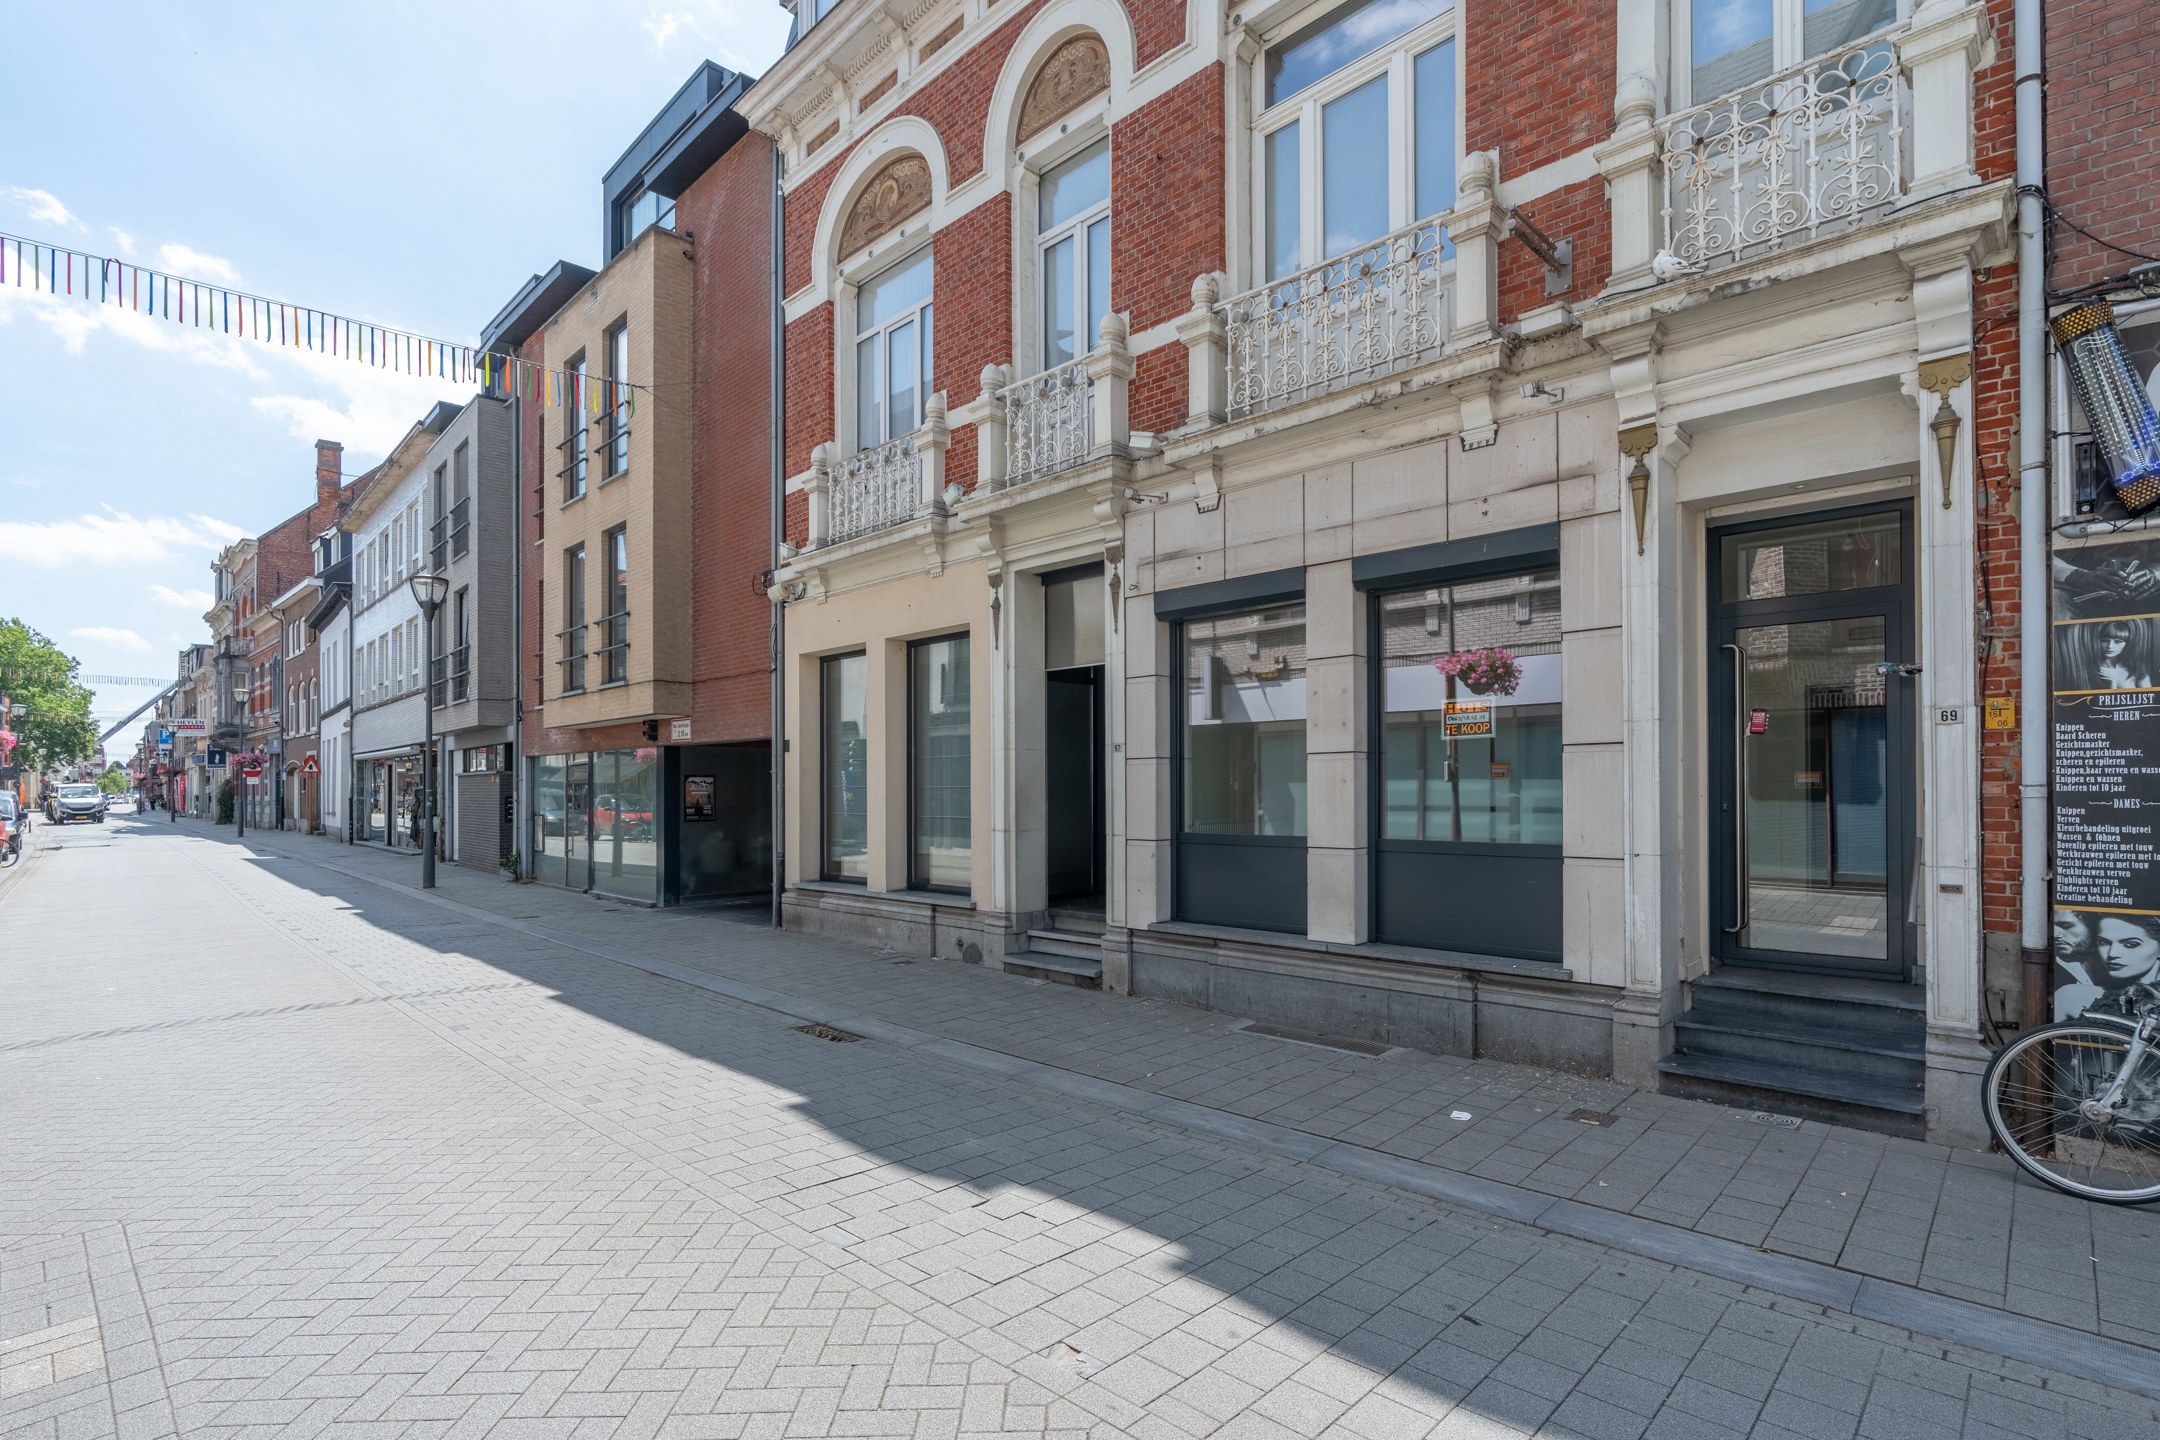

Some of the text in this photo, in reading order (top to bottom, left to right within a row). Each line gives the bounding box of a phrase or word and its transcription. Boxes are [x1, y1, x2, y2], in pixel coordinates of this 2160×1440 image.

[2099, 694, 2154, 706] PRIJSLIJST
[1447, 702, 1488, 713] HUIS
[1941, 710, 1958, 722] 69
[2114, 711, 2140, 720] HEREN
[1446, 723, 1490, 734] TE KOOP
[2111, 784, 2126, 792] jaar
[2114, 799, 2140, 808] DAMES
[2057, 807, 2085, 815] Knippen
[2057, 824, 2120, 833] Kleurbehandeling
[2057, 841, 2086, 850] Bovenlip
[2088, 842, 2118, 850] epileren
[2084, 860, 2114, 868] epileren
[2057, 867, 2130, 877] Wenkbrauwen verven
[2057, 876, 2093, 884] Highlights
[2057, 884, 2088, 893] Kinderen
[2112, 887, 2127, 895] jaar
[2088, 895, 2133, 905] behandeling
